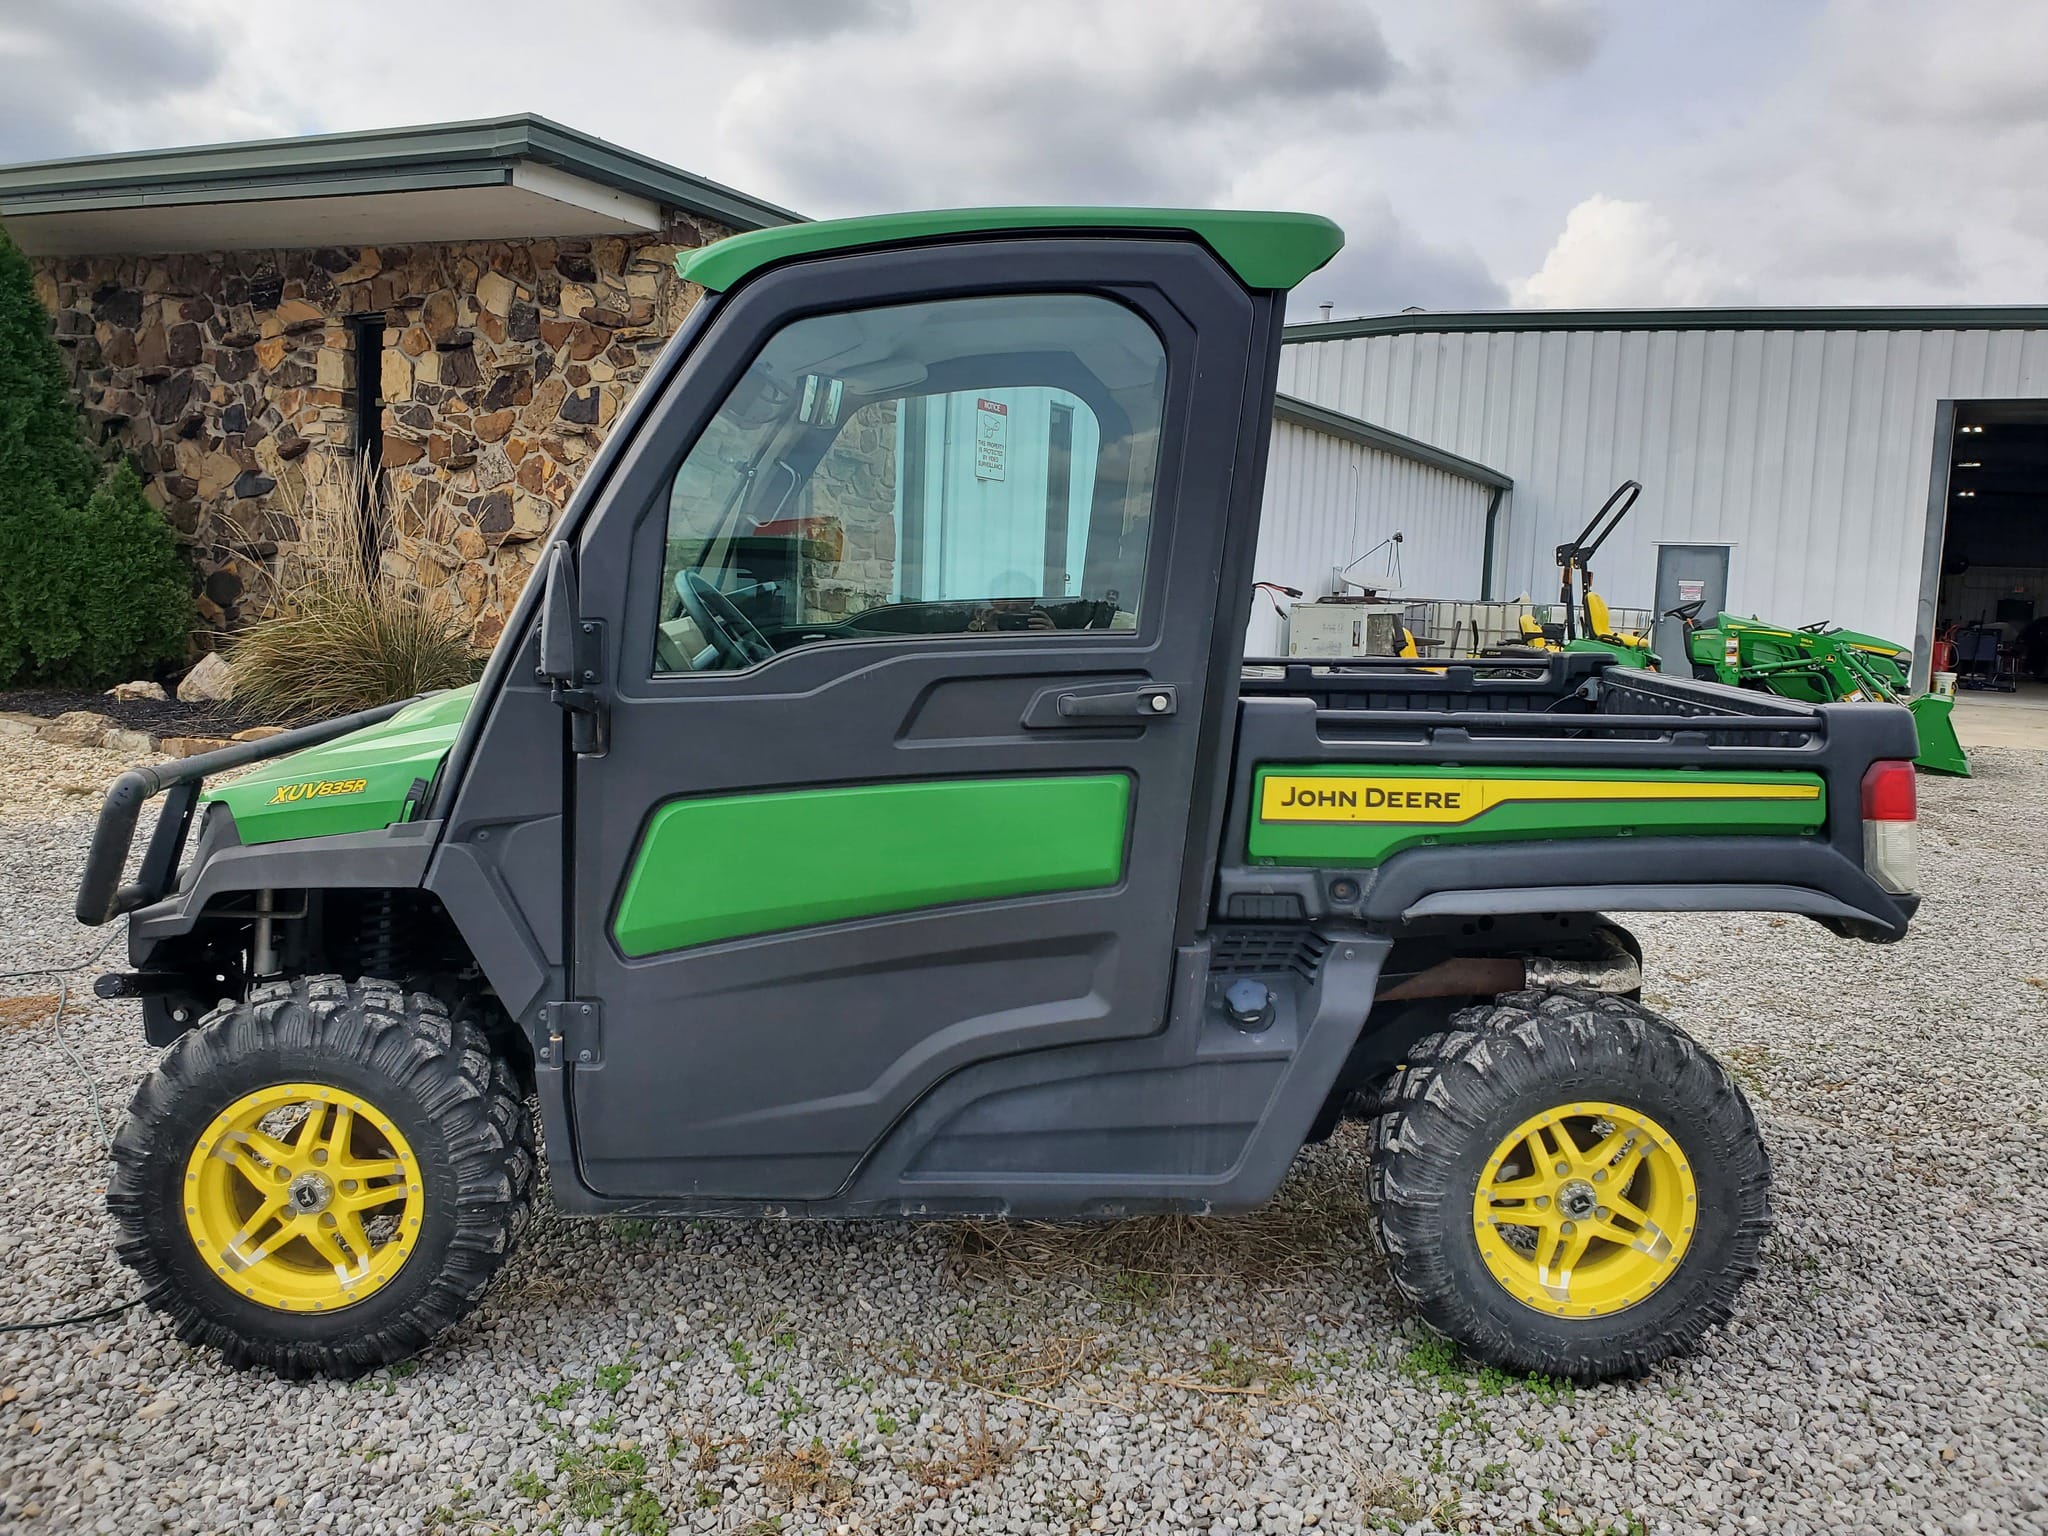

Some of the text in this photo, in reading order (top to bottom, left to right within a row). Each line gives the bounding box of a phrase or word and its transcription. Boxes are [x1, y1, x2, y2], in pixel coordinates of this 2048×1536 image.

[983, 401, 1001, 412] NOTICE
[986, 441, 1004, 450] PROPERTY
[268, 778, 367, 805] XUV835R
[1281, 786, 1461, 809] JOHN DEERE
